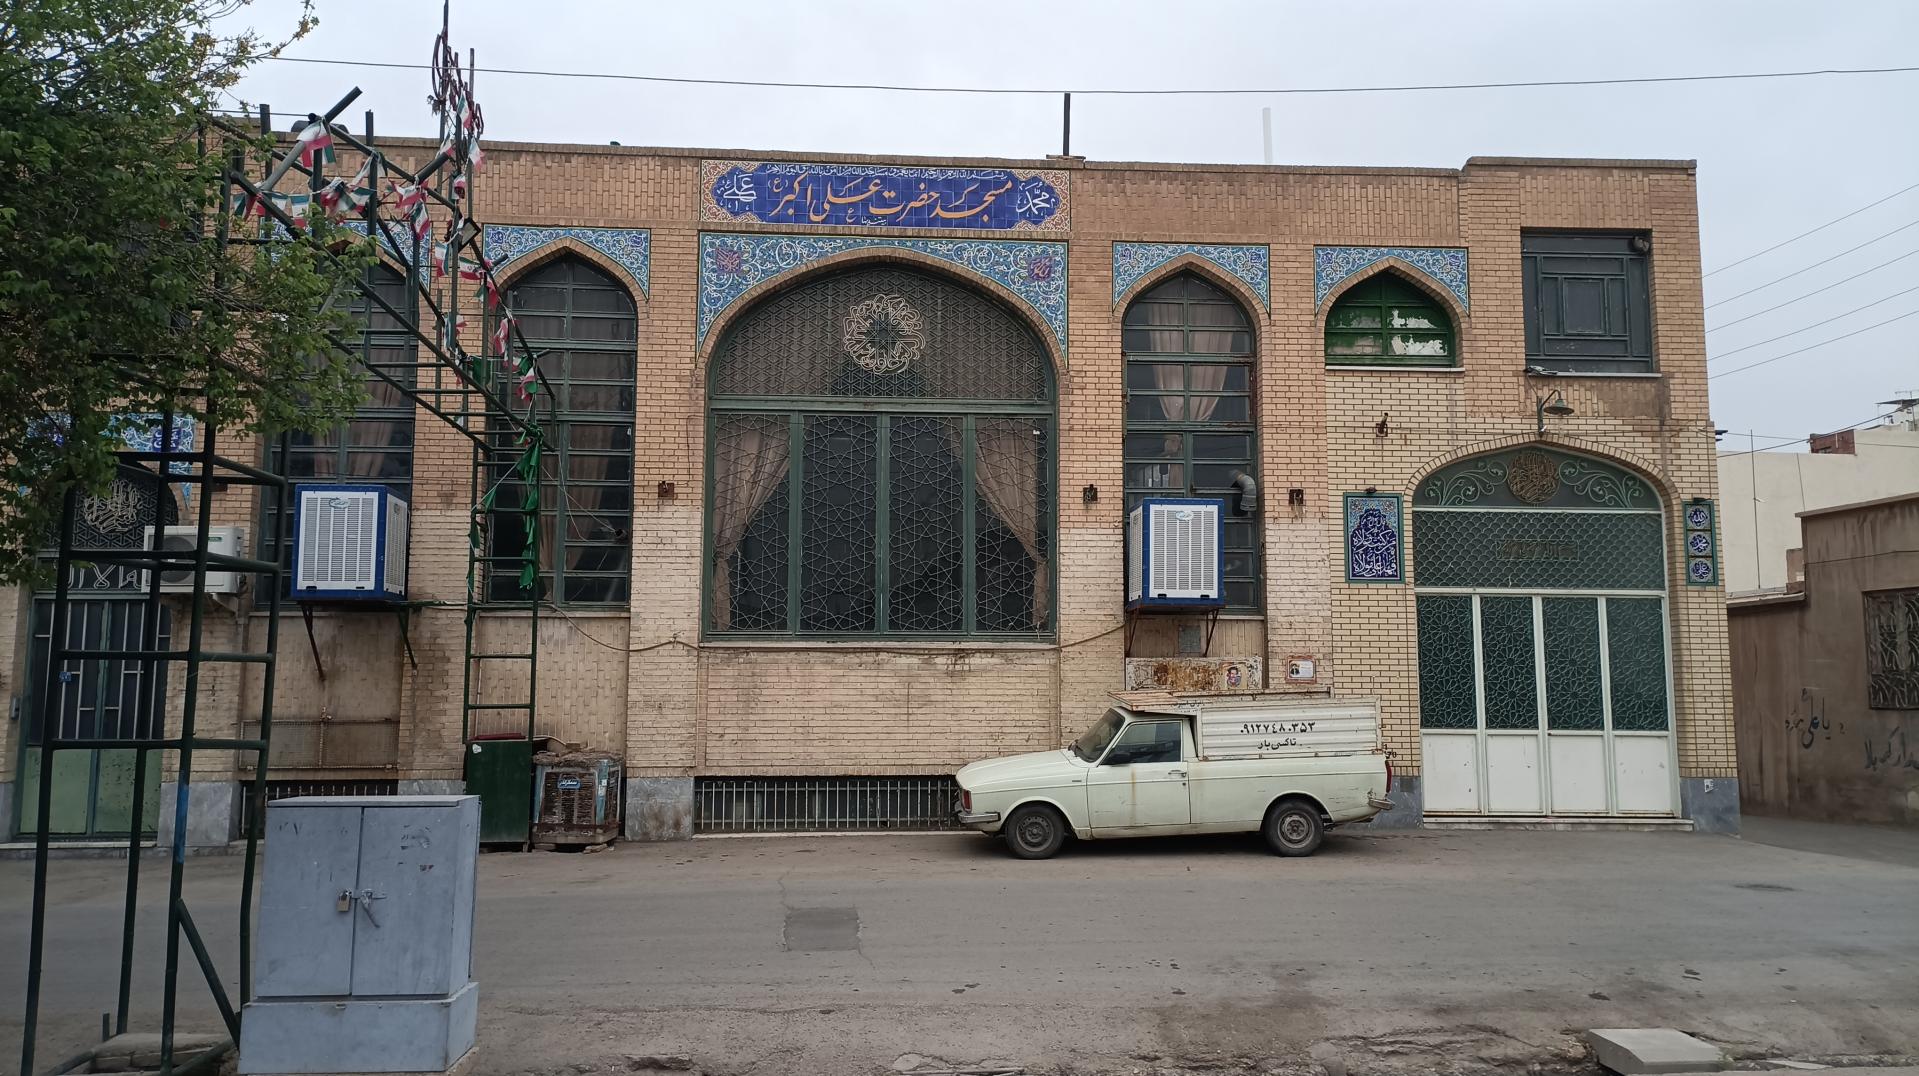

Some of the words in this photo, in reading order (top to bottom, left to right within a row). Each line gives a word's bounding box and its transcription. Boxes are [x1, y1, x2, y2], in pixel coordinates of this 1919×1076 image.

[768, 171, 814, 217] اکبر
[808, 178, 883, 222] علی
[868, 181, 941, 223] حضرت
[929, 179, 1013, 223] مسجد
